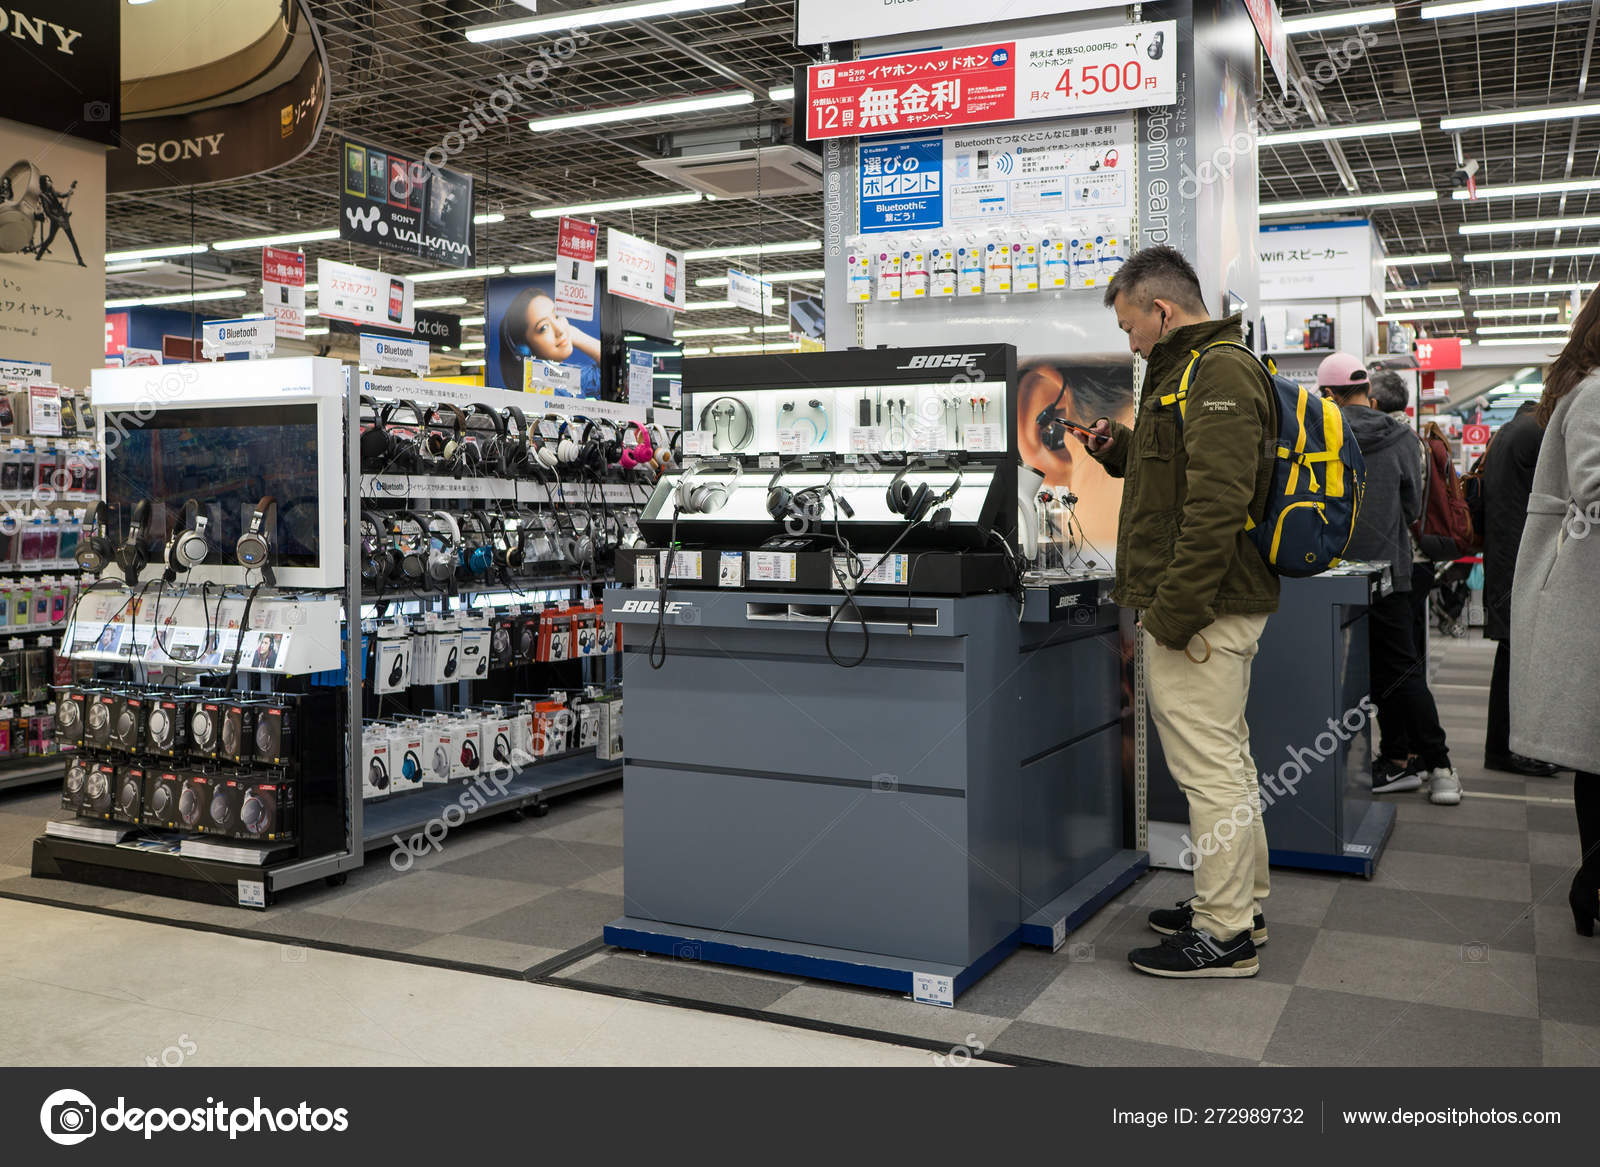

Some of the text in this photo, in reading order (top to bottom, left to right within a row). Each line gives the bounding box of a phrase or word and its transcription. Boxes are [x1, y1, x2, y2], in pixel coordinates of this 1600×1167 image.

[1029, 48, 1054, 59] 例えば
[868, 54, 989, 79] イヤホン・ヘッドホン
[1029, 57, 1074, 69] ヘッドホンが
[1030, 90, 1051, 101] 月々
[859, 78, 961, 129] 無金利
[906, 111, 953, 124] キャンペーン
[136, 132, 225, 166] SONY
[863, 154, 920, 176] 選びの
[864, 174, 937, 195] ポイント
[391, 213, 416, 225] SONY
[826, 171, 845, 257] earphone
[1288, 248, 1349, 261] スピーカー
[331, 279, 377, 297] スマホアプリ
[0, 301, 72, 320] ワイヤレス。
[226, 326, 258, 338] Bluetooth
[384, 344, 413, 357] Bluetooth
[896, 353, 986, 370] BOSE
[370, 384, 393, 392] Bluetooth
[611, 600, 693, 615] BOSE
